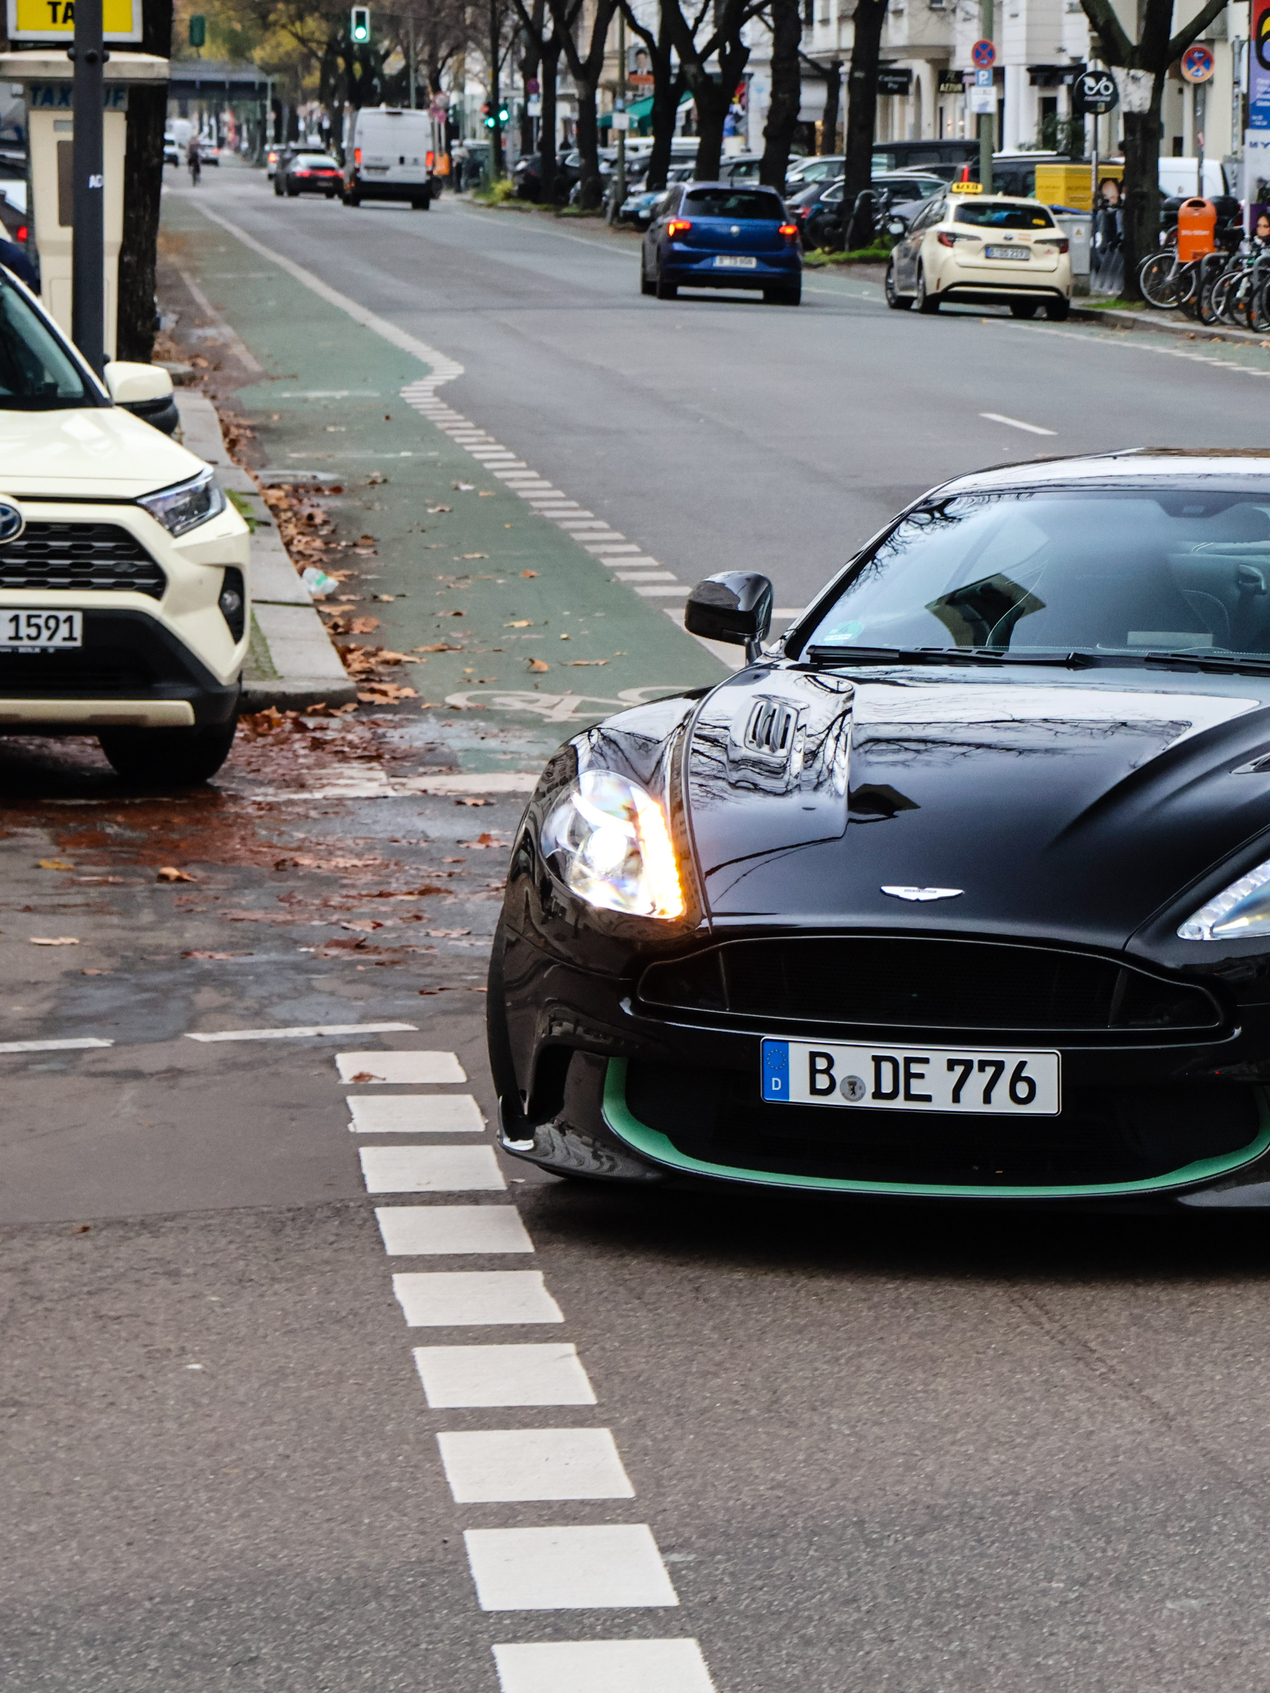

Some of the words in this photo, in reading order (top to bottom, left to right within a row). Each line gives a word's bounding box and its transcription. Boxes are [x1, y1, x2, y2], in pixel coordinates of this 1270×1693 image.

[7, 614, 78, 642] 1591
[771, 1077, 782, 1091] D
[808, 1050, 837, 1097] B
[871, 1054, 933, 1103] DE
[946, 1058, 1037, 1106] 776
